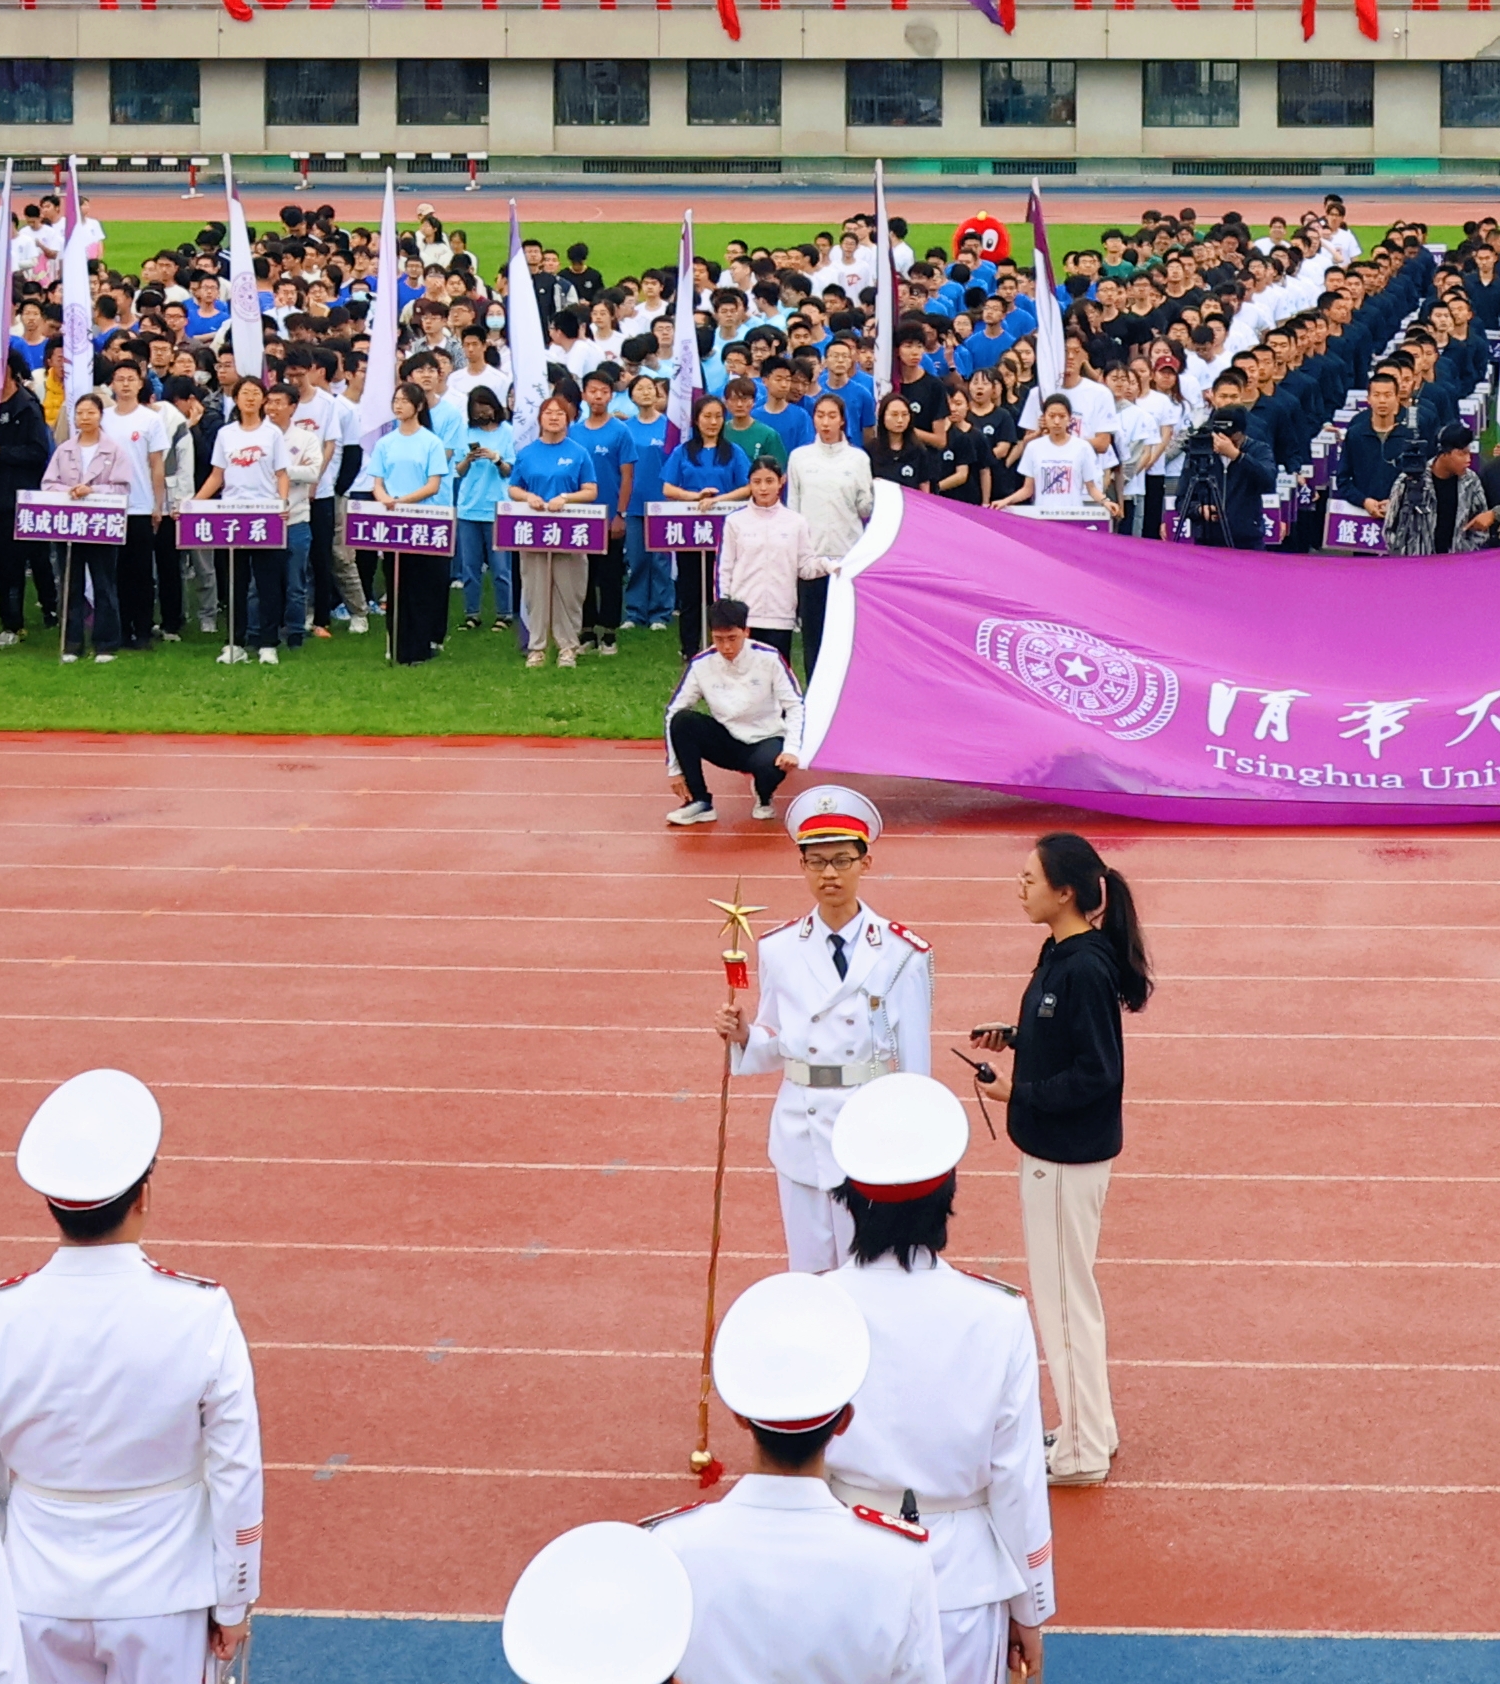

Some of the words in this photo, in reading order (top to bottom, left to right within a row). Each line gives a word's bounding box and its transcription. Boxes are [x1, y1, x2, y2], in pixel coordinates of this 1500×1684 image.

[17, 508, 125, 538] 集成电路学院
[195, 518, 267, 543] 电子系
[351, 521, 449, 548] 工业工程系
[514, 521, 589, 547] 能动系
[1336, 519, 1381, 546] 篮球
[1113, 670, 1159, 728] UNIVERSITY
[1206, 744, 1405, 789] Tsinghua
